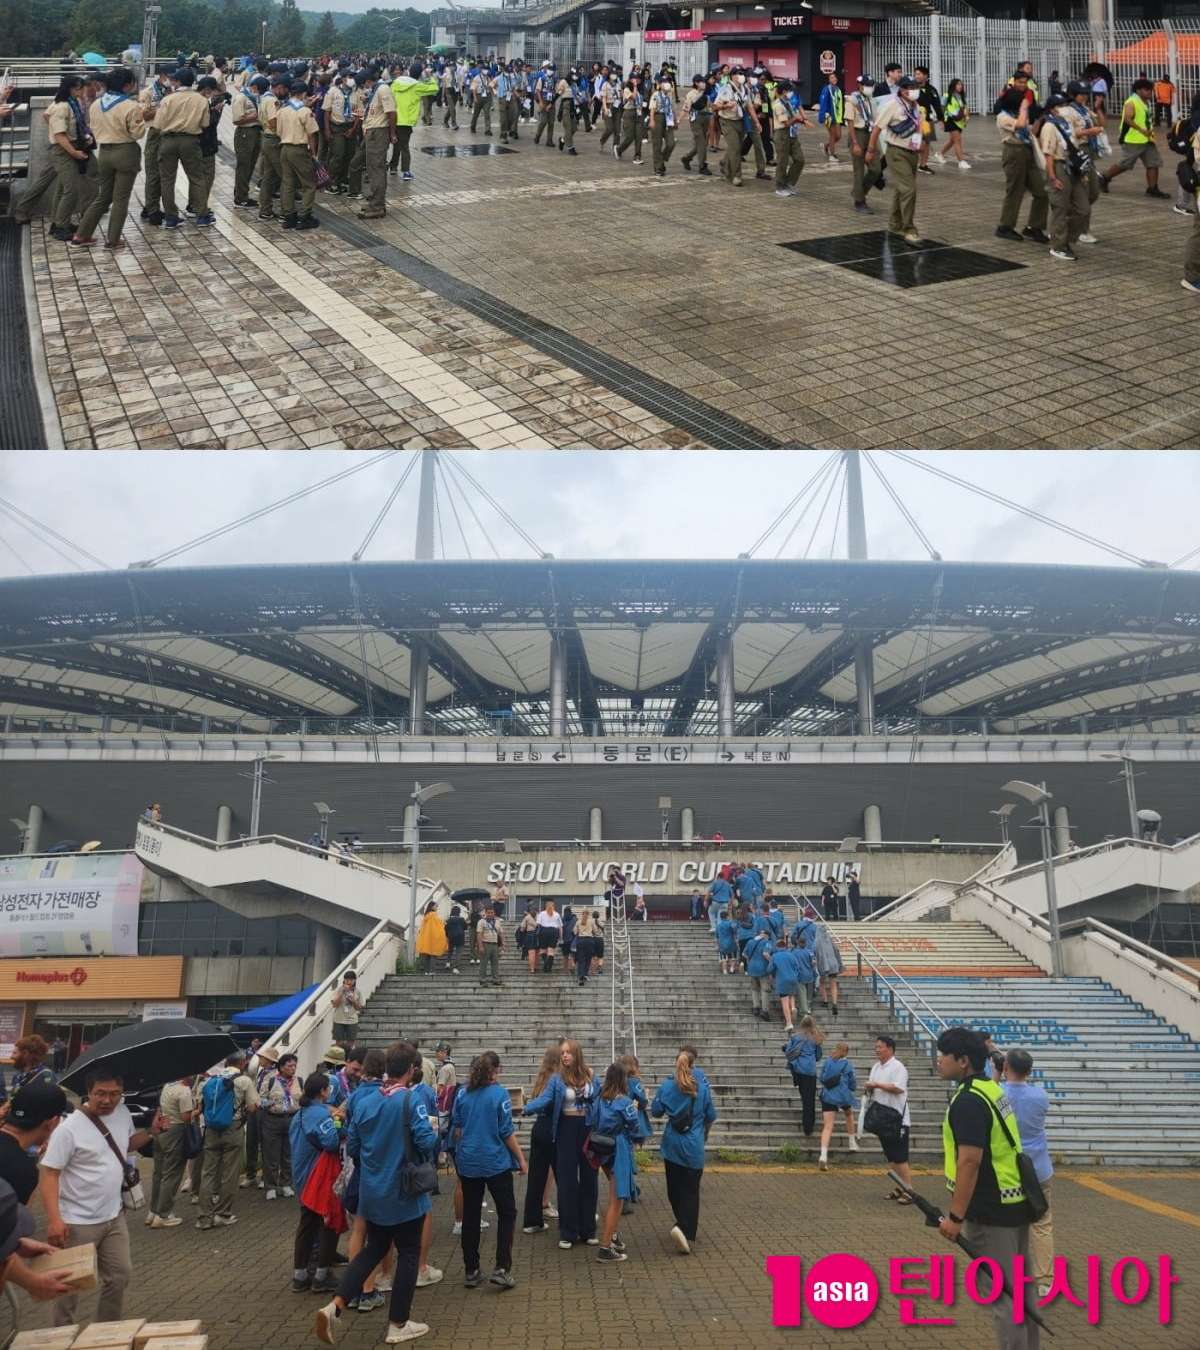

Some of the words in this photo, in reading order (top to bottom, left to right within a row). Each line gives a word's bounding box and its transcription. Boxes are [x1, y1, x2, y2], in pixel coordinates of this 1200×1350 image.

[773, 15, 804, 26] TICKET
[487, 861, 566, 883] SEOUL
[576, 861, 668, 883] WORLD
[44, 890, 101, 910] 가전매장
[16, 971, 70, 984] Homeplus
